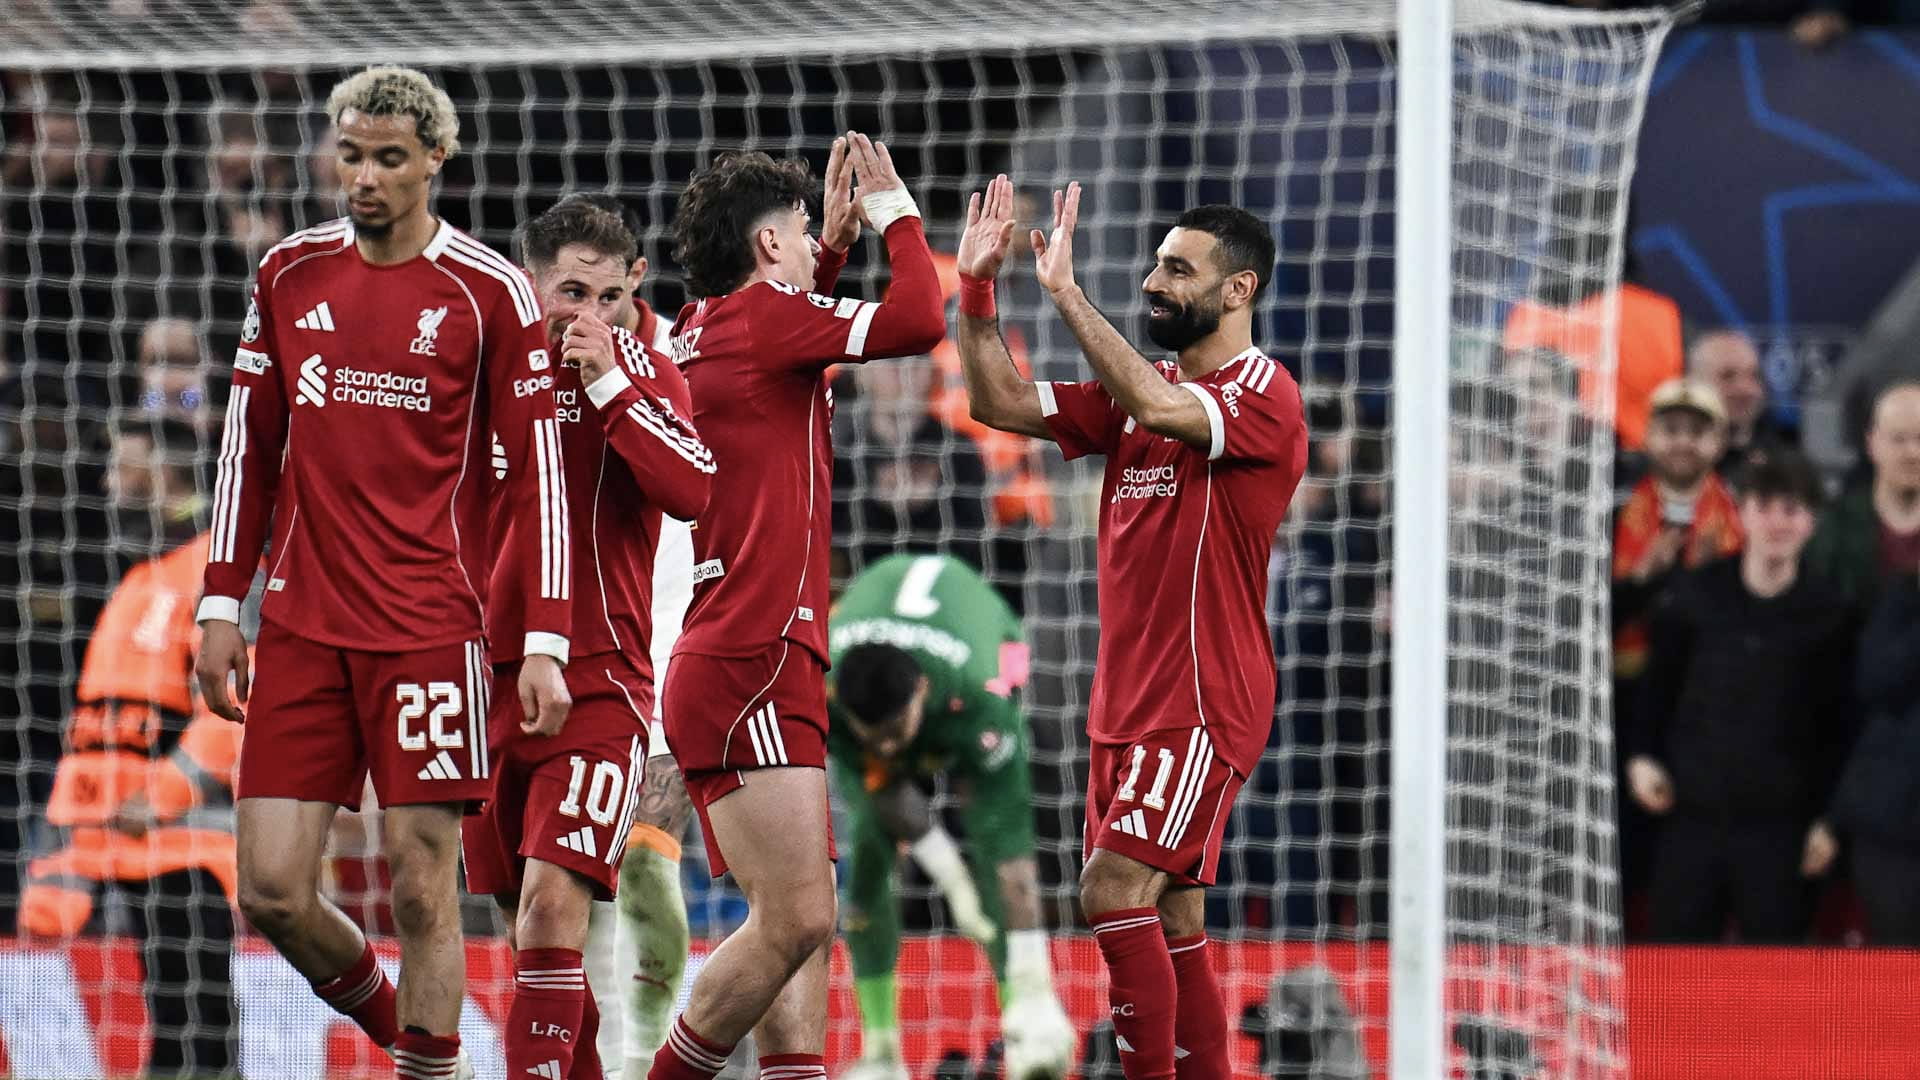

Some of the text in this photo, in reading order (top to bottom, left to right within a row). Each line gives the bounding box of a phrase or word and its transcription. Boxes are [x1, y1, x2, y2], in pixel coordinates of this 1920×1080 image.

[334, 366, 427, 394] standard
[332, 384, 431, 412] chartered
[553, 388, 577, 405] rd
[396, 681, 464, 751] 22
[558, 755, 624, 827] 10
[1118, 744, 1175, 811] 11
[1111, 1003, 1134, 1016] FC
[530, 1021, 572, 1044] LFC
